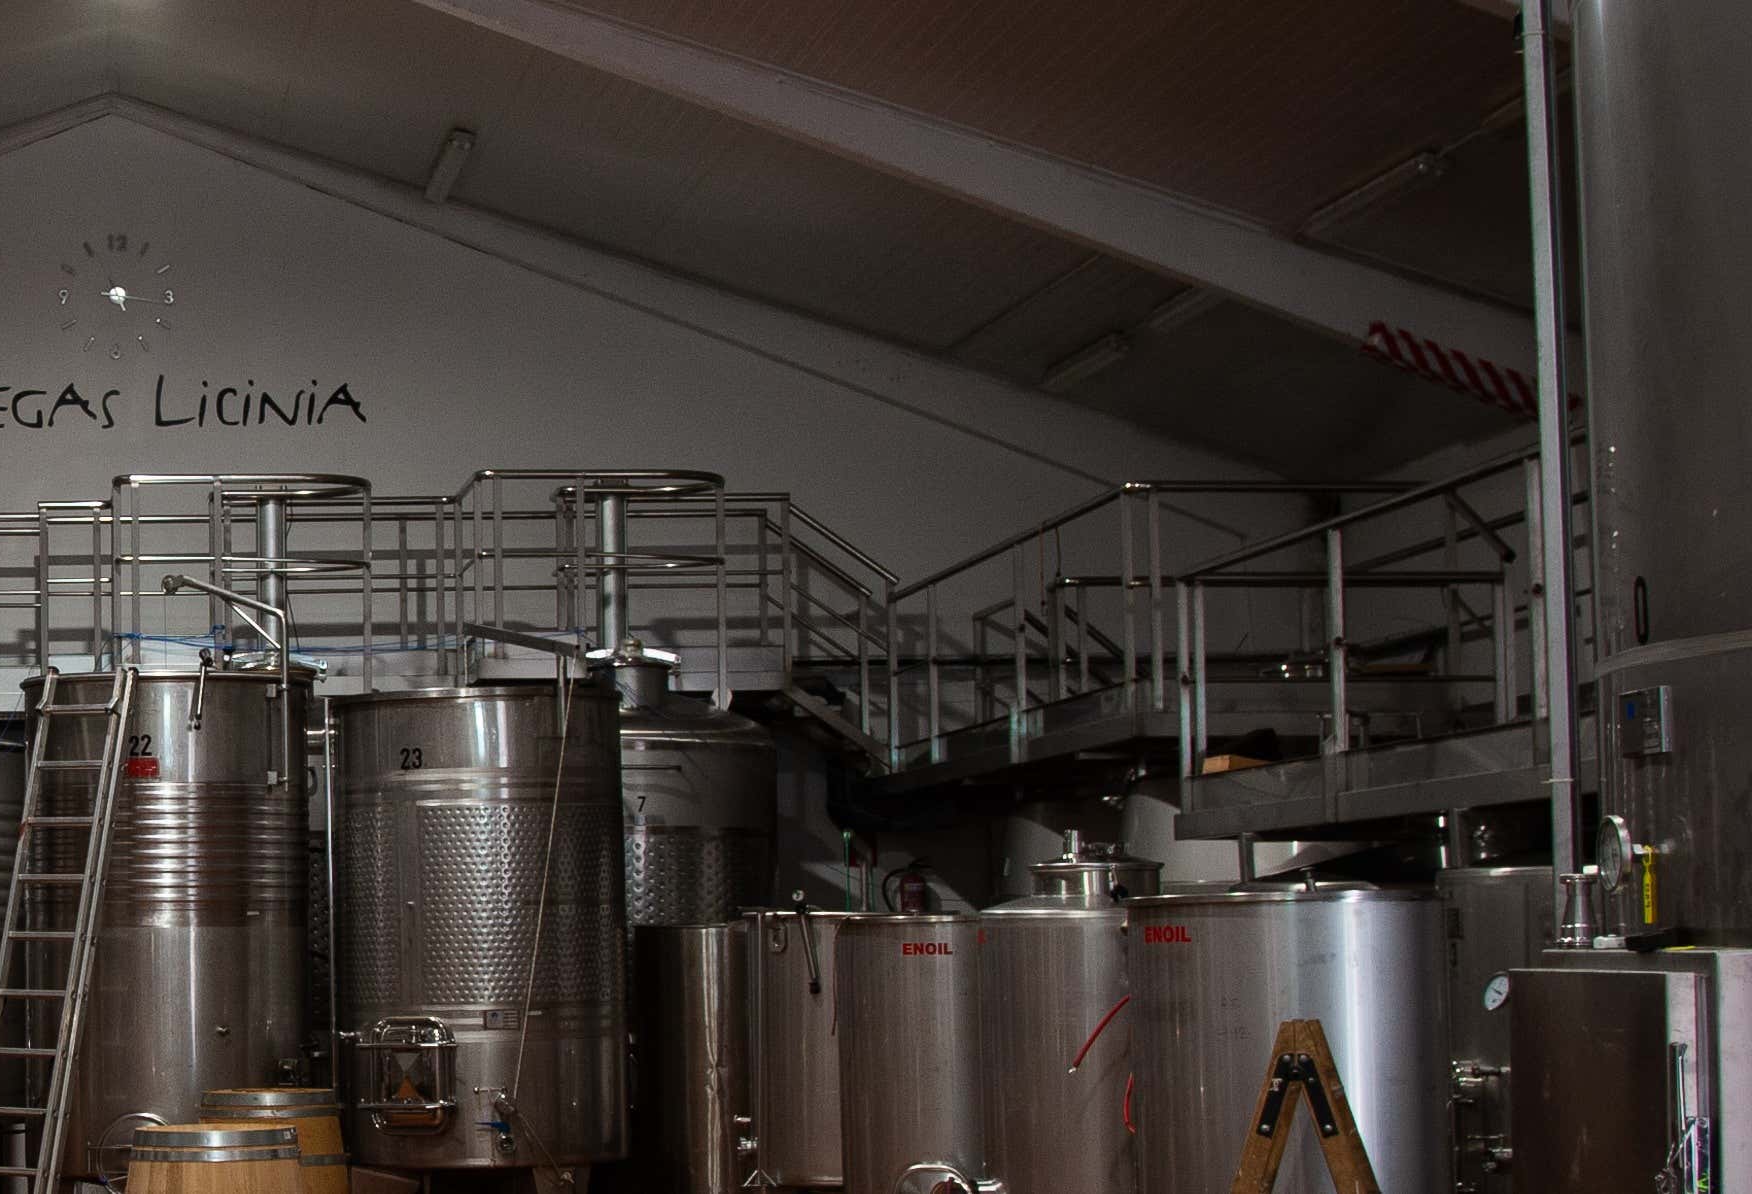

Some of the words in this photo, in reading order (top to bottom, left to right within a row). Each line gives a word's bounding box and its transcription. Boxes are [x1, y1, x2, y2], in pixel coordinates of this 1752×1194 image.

[107, 234, 127, 252] 12
[59, 289, 69, 305] 9
[164, 289, 175, 305] 3
[129, 734, 152, 756] 22
[400, 747, 422, 769] 23
[637, 796, 646, 813] 7
[1144, 925, 1192, 943] ENOIL
[903, 942, 953, 955] ENOIL
